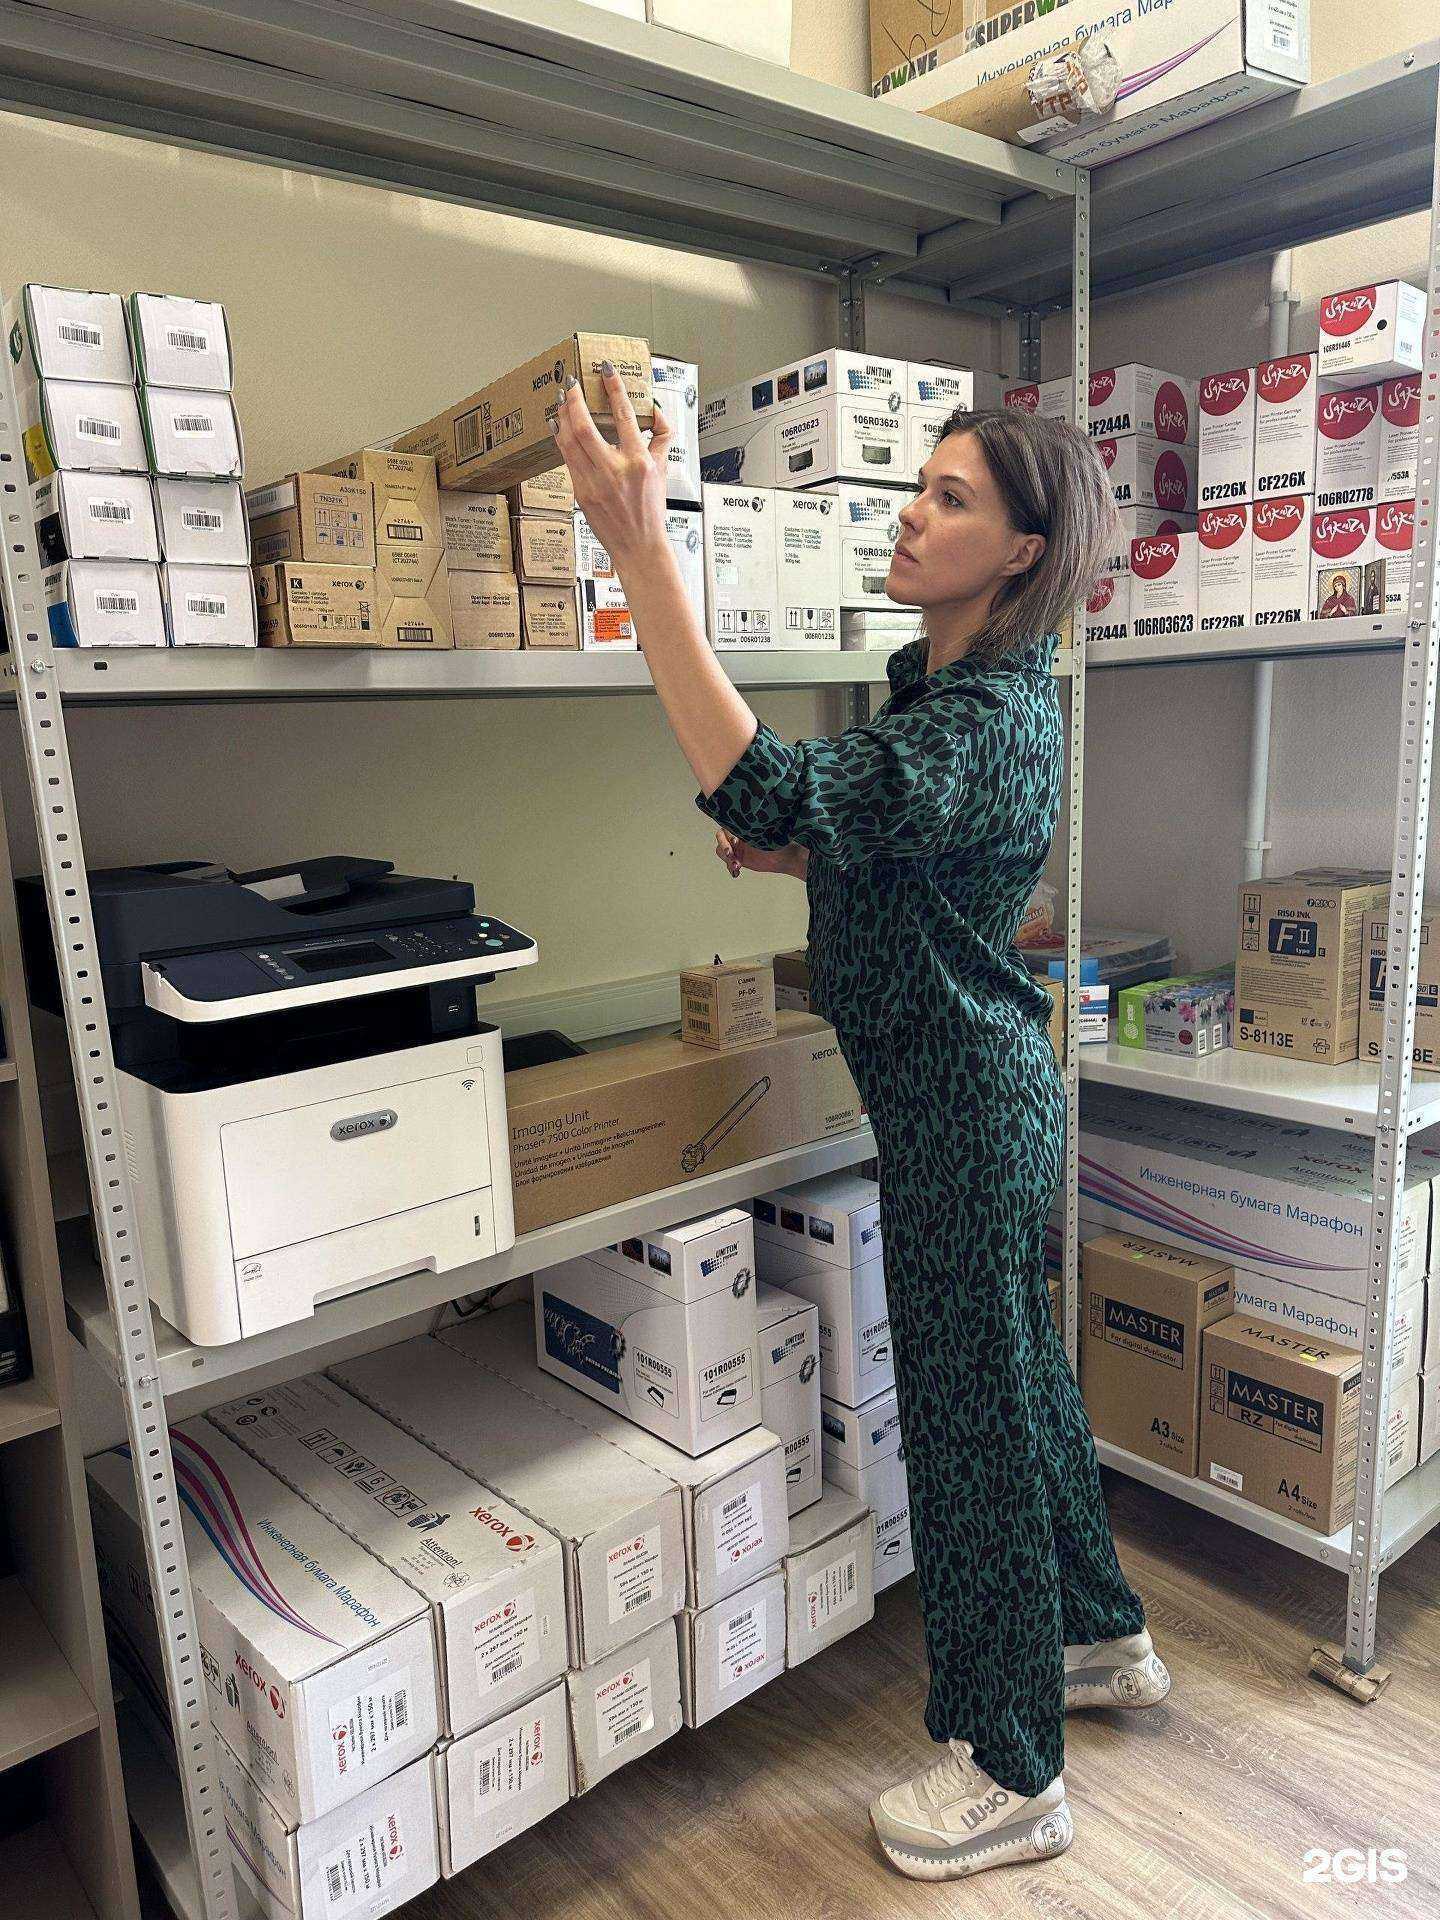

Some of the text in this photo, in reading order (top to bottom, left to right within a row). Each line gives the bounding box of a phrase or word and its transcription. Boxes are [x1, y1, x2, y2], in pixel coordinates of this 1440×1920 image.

[1159, 84, 1251, 131] Марафон
[532, 371, 552, 392] xerox
[865, 365, 892, 379] UNITON
[935, 377, 960, 389] UNITON
[705, 398, 726, 415] UNITON
[781, 418, 820, 439] 106R03623
[853, 414, 899, 429] 106R03623
[1202, 481, 1247, 501] CF226X
[1258, 471, 1306, 492] CF226X
[723, 497, 749, 508] xerox
[793, 500, 817, 510] xerox
[866, 497, 890, 509] UNITON
[1317, 487, 1374, 507] 106R02778
[854, 547, 895, 557] 106R0362
[332, 580, 353, 588] xerox
[1133, 614, 1194, 636] 106R03623
[1201, 614, 1245, 631] CF226X
[1255, 609, 1302, 626] CF226X
[1277, 909, 1311, 919] RISO INK
[1295, 948, 1311, 956] type
[737, 977, 756, 985] Canon
[1239, 1026, 1294, 1049] S-8113E
[811, 1046, 839, 1062] xerox
[337, 1119, 375, 1136] xerox
[512, 1109, 590, 1140] Imaging Unit
[548, 1130, 569, 1144] 7500
[570, 1124, 592, 1137] Color
[592, 1118, 620, 1132] Printer
[514, 1155, 532, 1168] Unité
[532, 1151, 559, 1163] imageur
[582, 1136, 613, 1149] Immagine
[514, 1165, 539, 1178] Unidad
[539, 1163, 548, 1172] de
[547, 1157, 572, 1170] imagen
[577, 1148, 602, 1160] Unidade
[602, 1146, 611, 1154] de
[515, 1155, 613, 1188] Блок формирования изображения
[1299, 1154, 1367, 1174] xerox
[1139, 1165, 1226, 1201] Инженерная
[1229, 1189, 1281, 1216] бумага
[1286, 1205, 1364, 1237] Марафон
[715, 1243, 738, 1258] UNITON
[1109, 1307, 1181, 1346] MASTER
[1282, 1302, 1359, 1338] Марафон
[785, 1330, 806, 1346] UNITON
[1111, 1332, 1177, 1362] For digital duplicator
[1241, 1327, 1331, 1360] MASTER
[636, 1351, 673, 1378] 101R00555
[703, 1353, 746, 1382] 101R00555
[1231, 1381, 1319, 1427] MASTER
[1151, 1417, 1170, 1438] A3
[1240, 1408, 1264, 1428] RZ
[785, 1435, 810, 1456] R00555
[1277, 1478, 1301, 1502] A4
[469, 1506, 514, 1538] xerox
[876, 1509, 908, 1535] 01R00555
[422, 1537, 463, 1568] Attention!
[608, 1544, 632, 1563] xerox
[742, 1537, 764, 1555] xerox
[257, 1518, 381, 1627] Инженерная бумага Марафон
[474, 1610, 502, 1634] xerox
[744, 1652, 766, 1670] xerox
[235, 1650, 268, 1698] xerox
[596, 1680, 621, 1700] xerox
[533, 1720, 541, 1751] xerox
[337, 1741, 348, 1775] xerox
[387, 1814, 398, 1846] xerox
